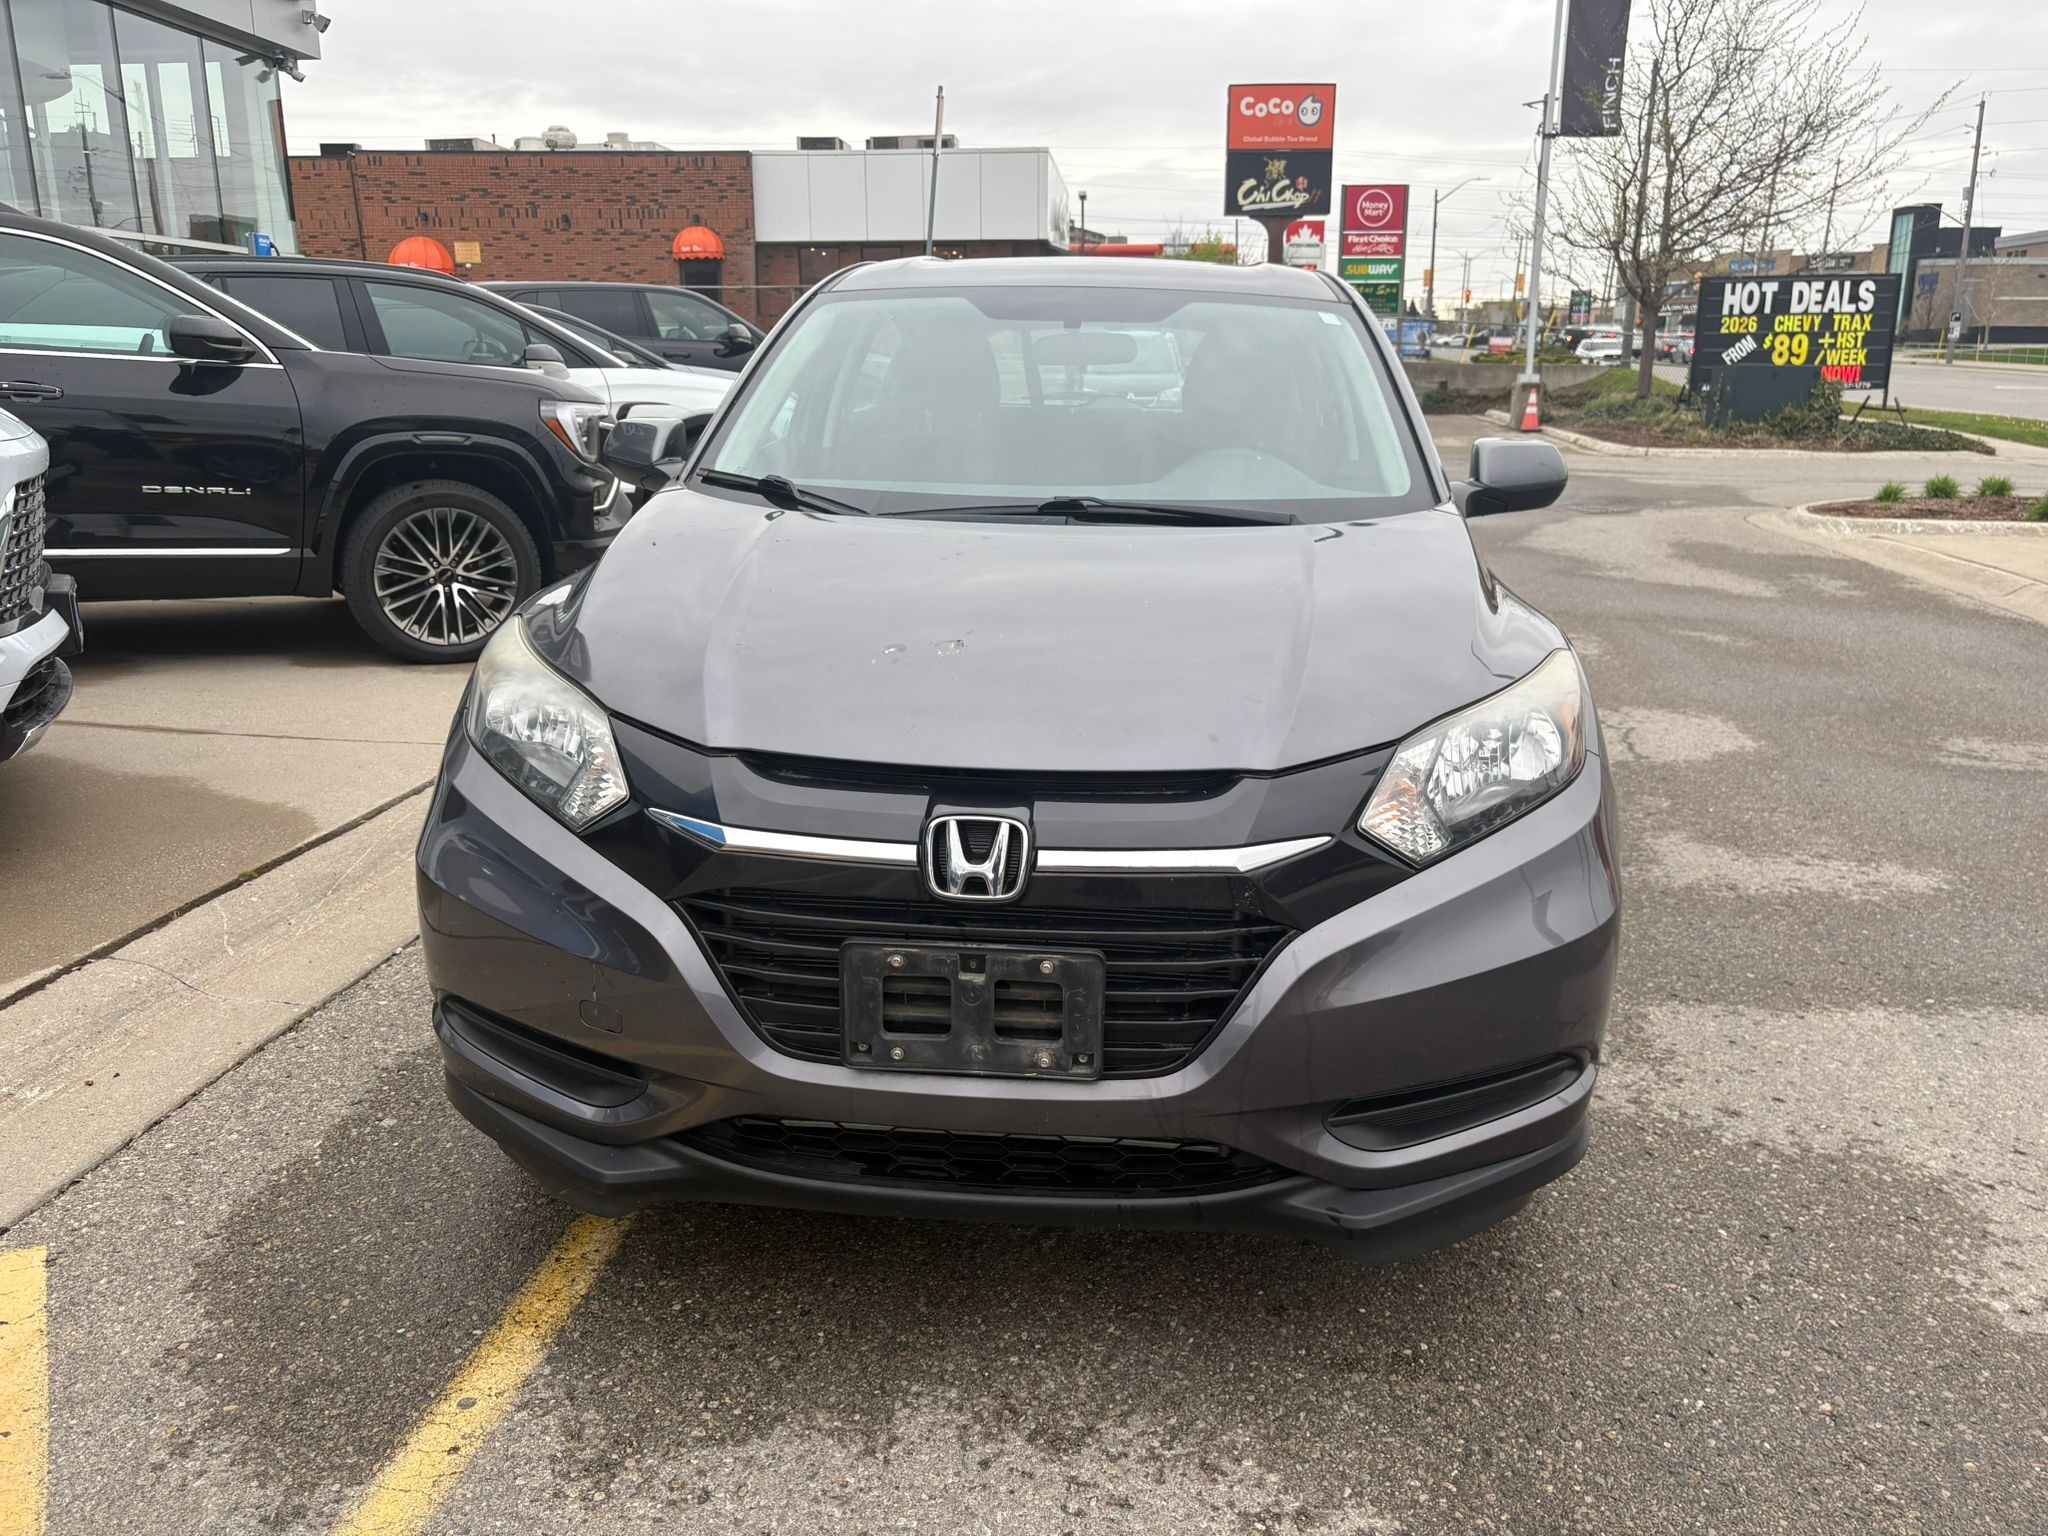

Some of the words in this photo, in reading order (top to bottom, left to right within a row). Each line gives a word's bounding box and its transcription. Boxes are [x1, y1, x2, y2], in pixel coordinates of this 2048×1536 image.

[1602, 57, 1621, 128] FINCH
[1362, 201, 1388, 211] Money
[1364, 208, 1383, 216] Mart
[1348, 234, 1368, 243] First
[1368, 234, 1398, 243] Choice
[1346, 264, 1398, 275] SUBWAY
[1721, 281, 1779, 316] HOT
[1789, 279, 1877, 314] DEALS
[1720, 316, 1758, 334] 2026
[1773, 314, 1823, 332] CHEVY
[1832, 313, 1874, 332] TRAX
[1721, 334, 1758, 366] FROM
[1820, 366, 1863, 384] NOW!
[141, 485, 252, 495] DENALI
